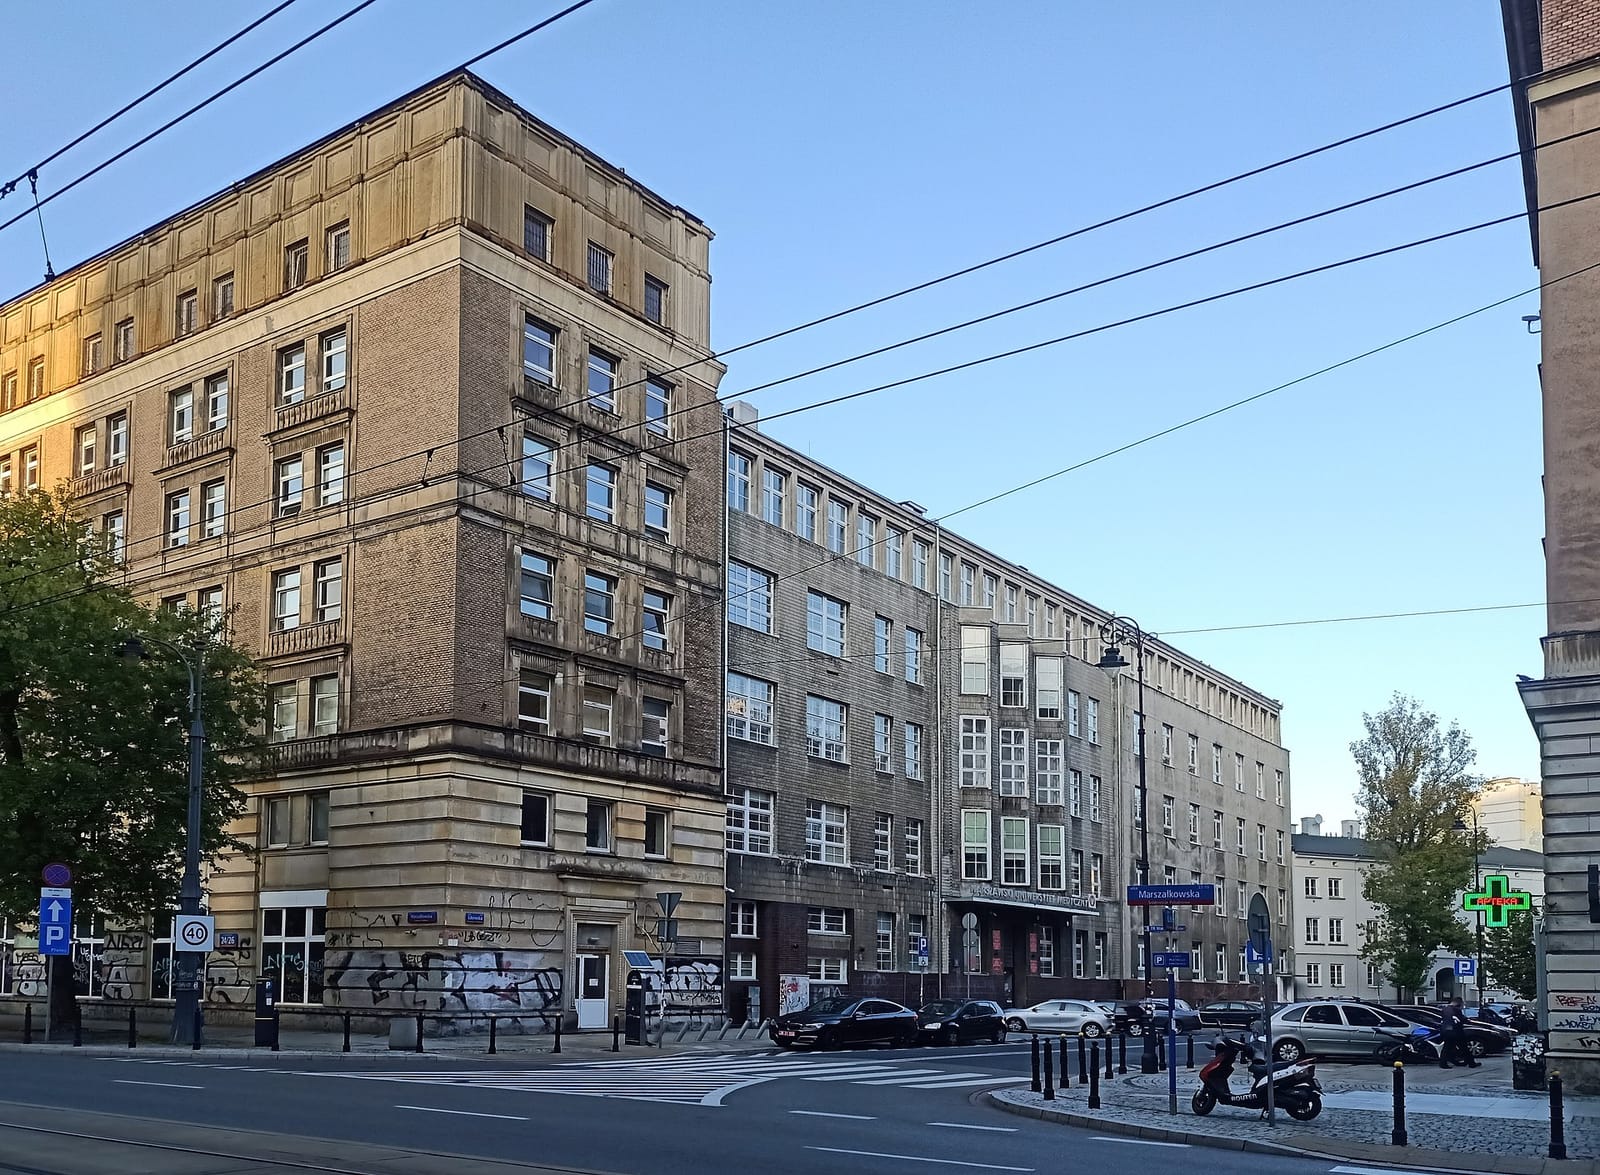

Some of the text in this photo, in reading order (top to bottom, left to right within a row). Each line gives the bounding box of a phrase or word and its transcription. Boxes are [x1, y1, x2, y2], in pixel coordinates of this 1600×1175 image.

[1477, 897, 1518, 906] APTEKA
[46, 926, 64, 946] P
[186, 928, 204, 940] 40
[920, 938, 927, 950] P
[1156, 956, 1163, 964] P
[1458, 961, 1471, 974] P
